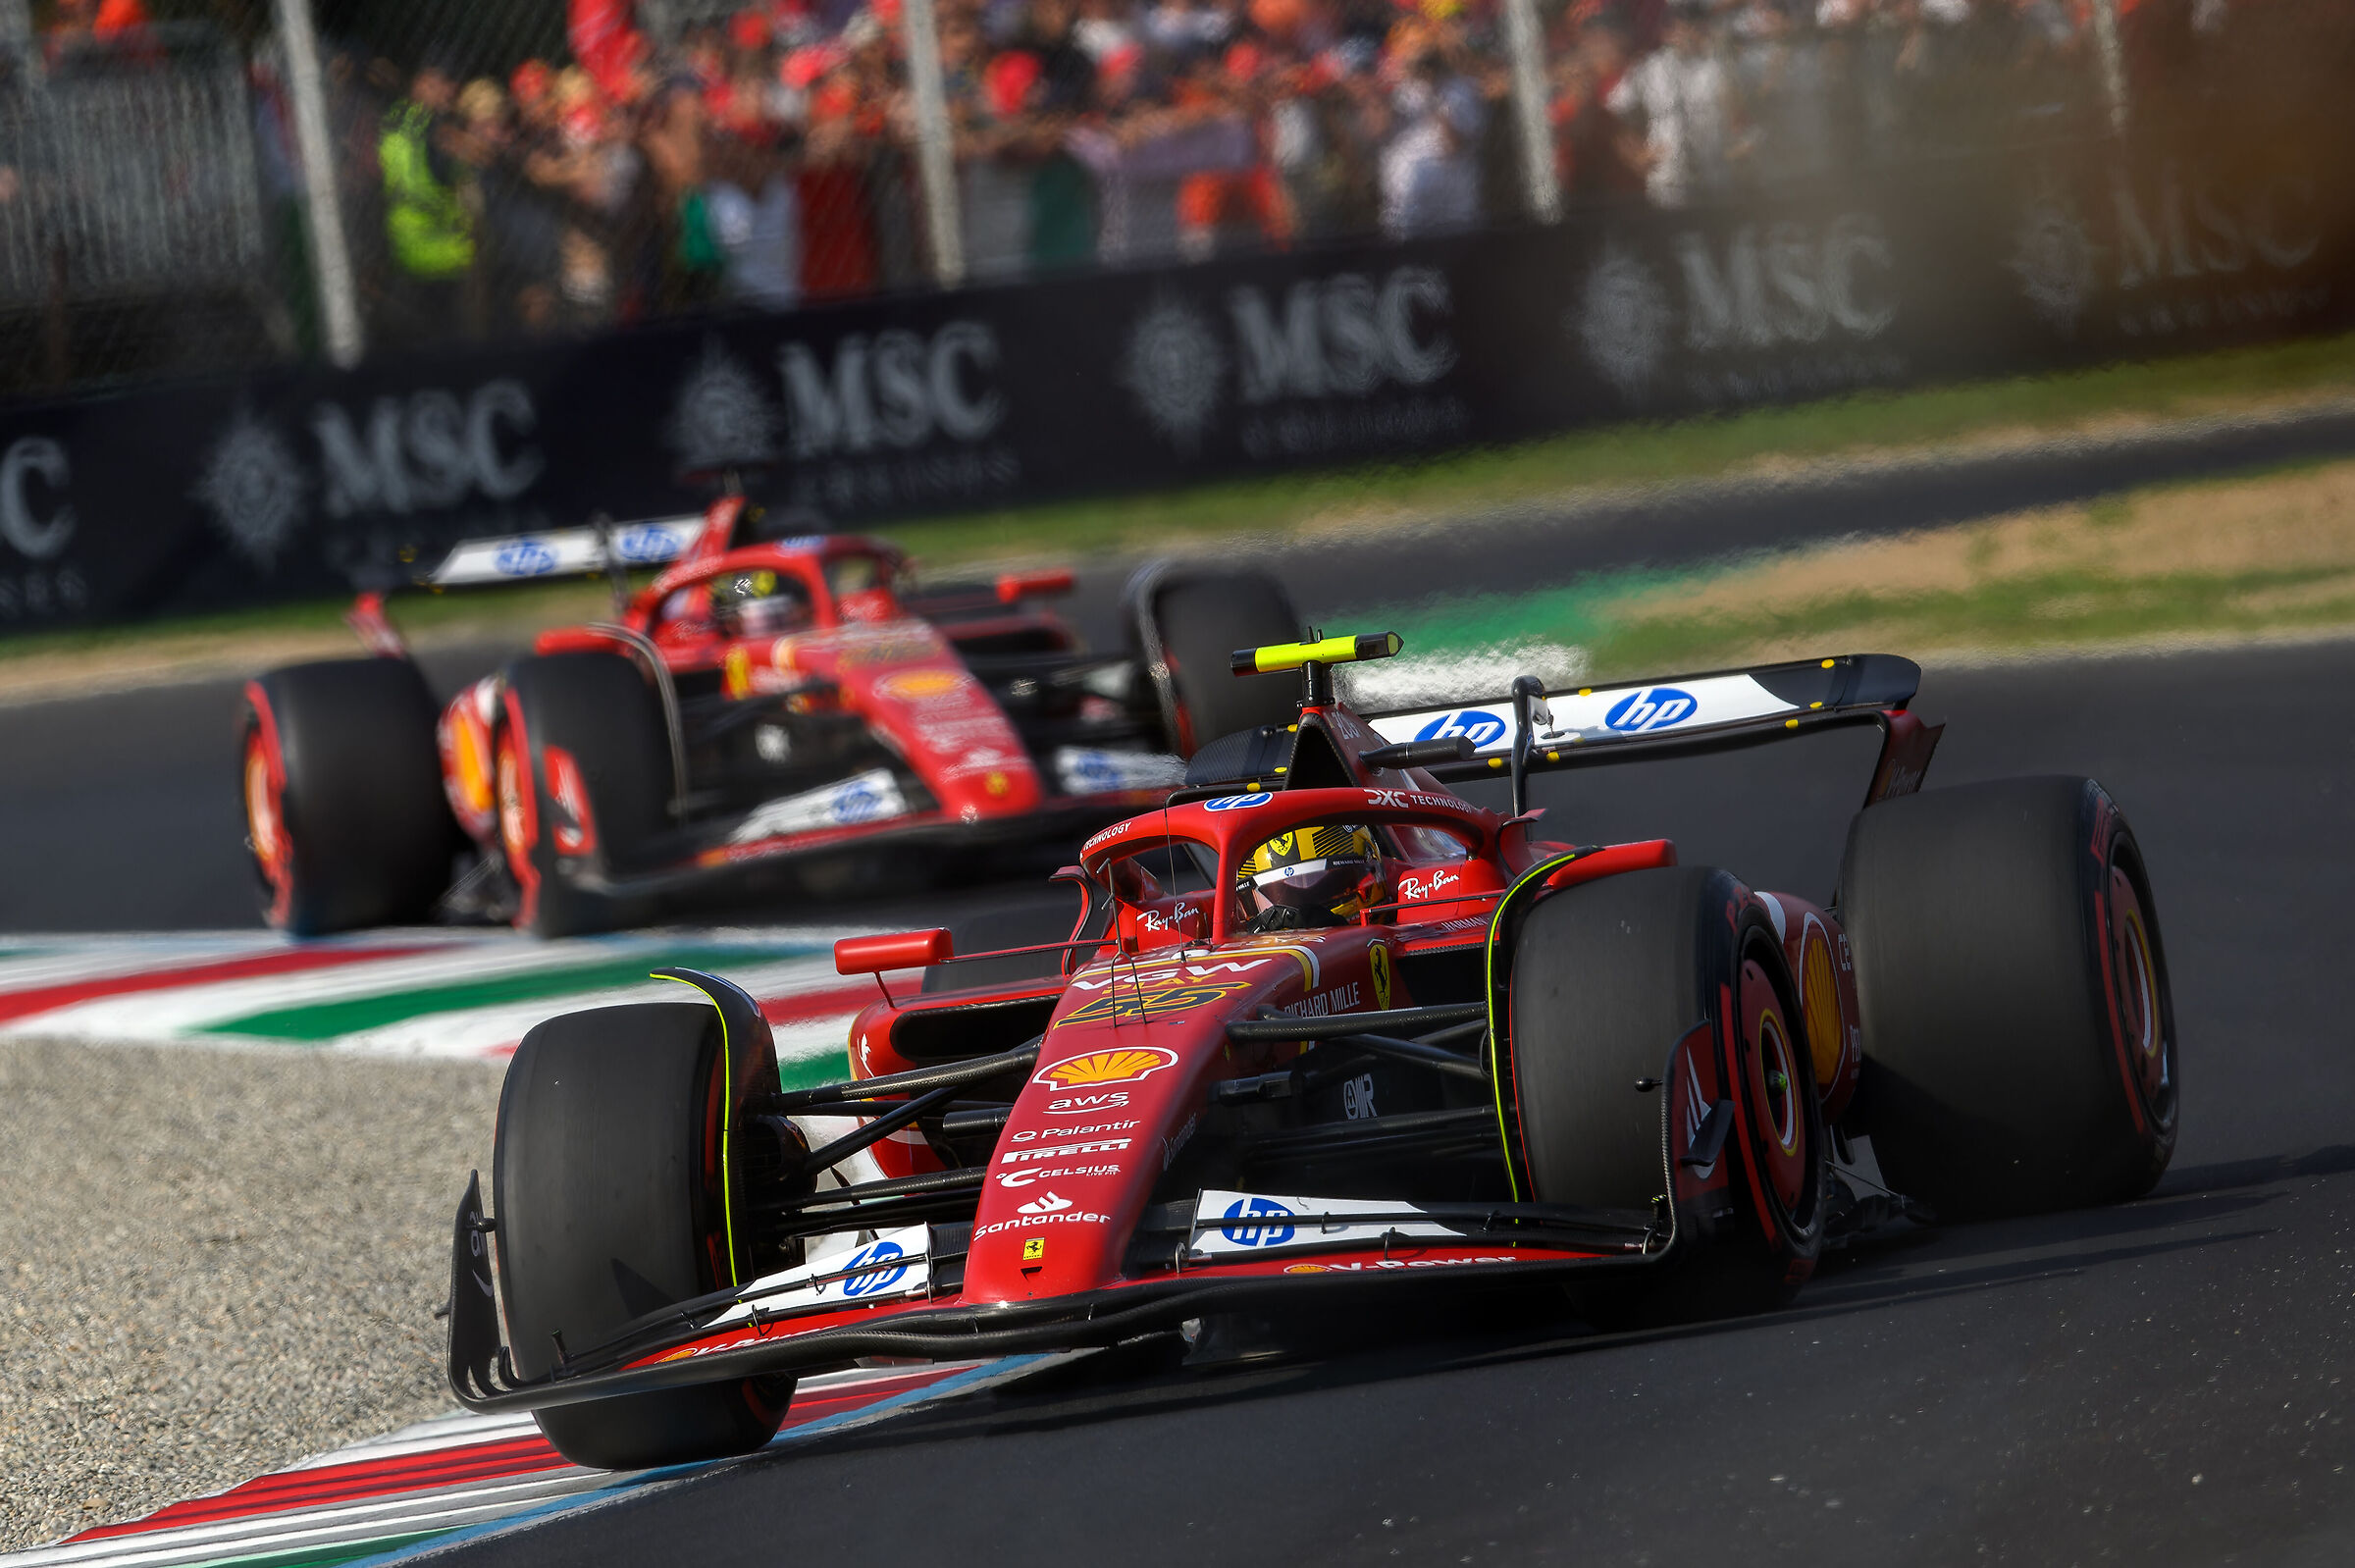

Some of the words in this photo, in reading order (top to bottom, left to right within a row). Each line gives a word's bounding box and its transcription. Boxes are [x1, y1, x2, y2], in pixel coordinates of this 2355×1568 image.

[1674, 215, 1899, 351] MSC
[1230, 266, 1460, 403] MSC
[781, 322, 1003, 457] MSC
[313, 382, 546, 517] MSC
[1609, 688, 1696, 731] hp
[1418, 710, 1502, 750] hp
[1363, 788, 1409, 809] DXC
[1284, 866, 1295, 877] hp
[1072, 959, 1273, 990] VGW
[1101, 974, 1217, 995] PLAY
[1053, 981, 1252, 1030] 55
[1330, 981, 1360, 1014] MILLE
[1047, 1091, 1130, 1112] aws
[1041, 1120, 1140, 1139] Palantir
[1001, 1138, 1132, 1165] PIRELLI
[1038, 1165, 1121, 1178] CELSIUS
[973, 1211, 1112, 1241] Santander
[1226, 1197, 1293, 1247] hp
[845, 1241, 905, 1296] hp
